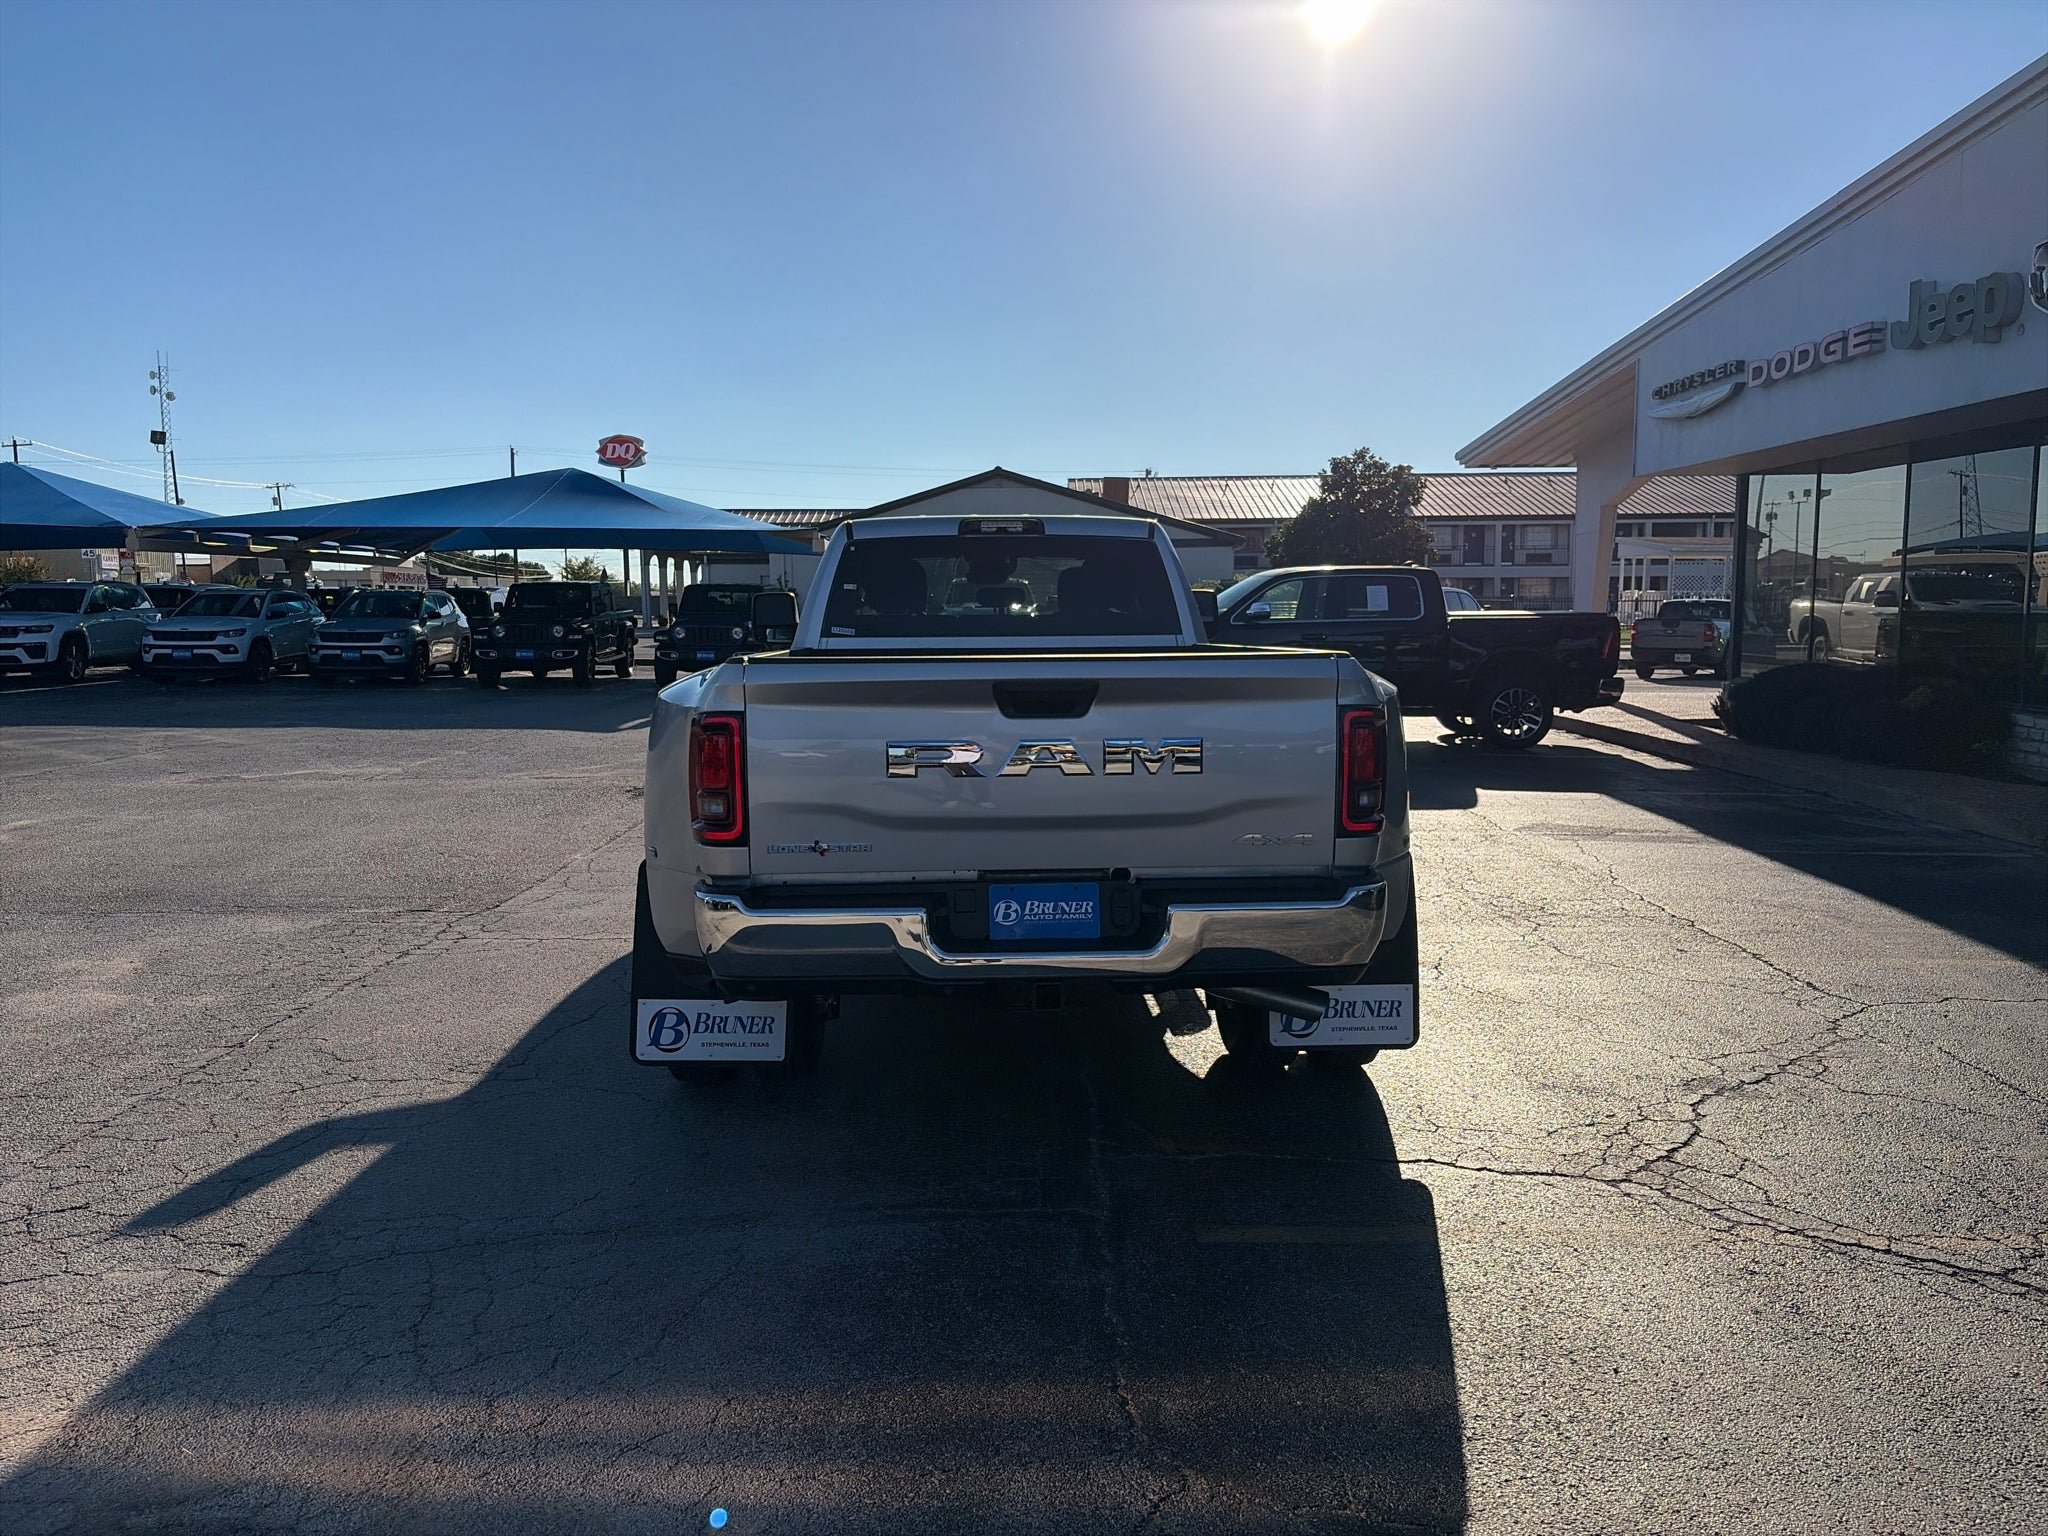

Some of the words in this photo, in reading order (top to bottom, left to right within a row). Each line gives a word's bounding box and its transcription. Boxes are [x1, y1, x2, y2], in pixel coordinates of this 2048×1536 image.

[1891, 271, 2025, 350] Jeep
[1748, 321, 1887, 388] DODGE
[1652, 360, 1745, 400] CHRYSLER
[605, 442, 636, 461] DQ
[886, 738, 1203, 777] RAM
[1024, 900, 1093, 914] BRUNER
[693, 1012, 775, 1034] BRUNER
[1323, 997, 1402, 1019] BRUNER
